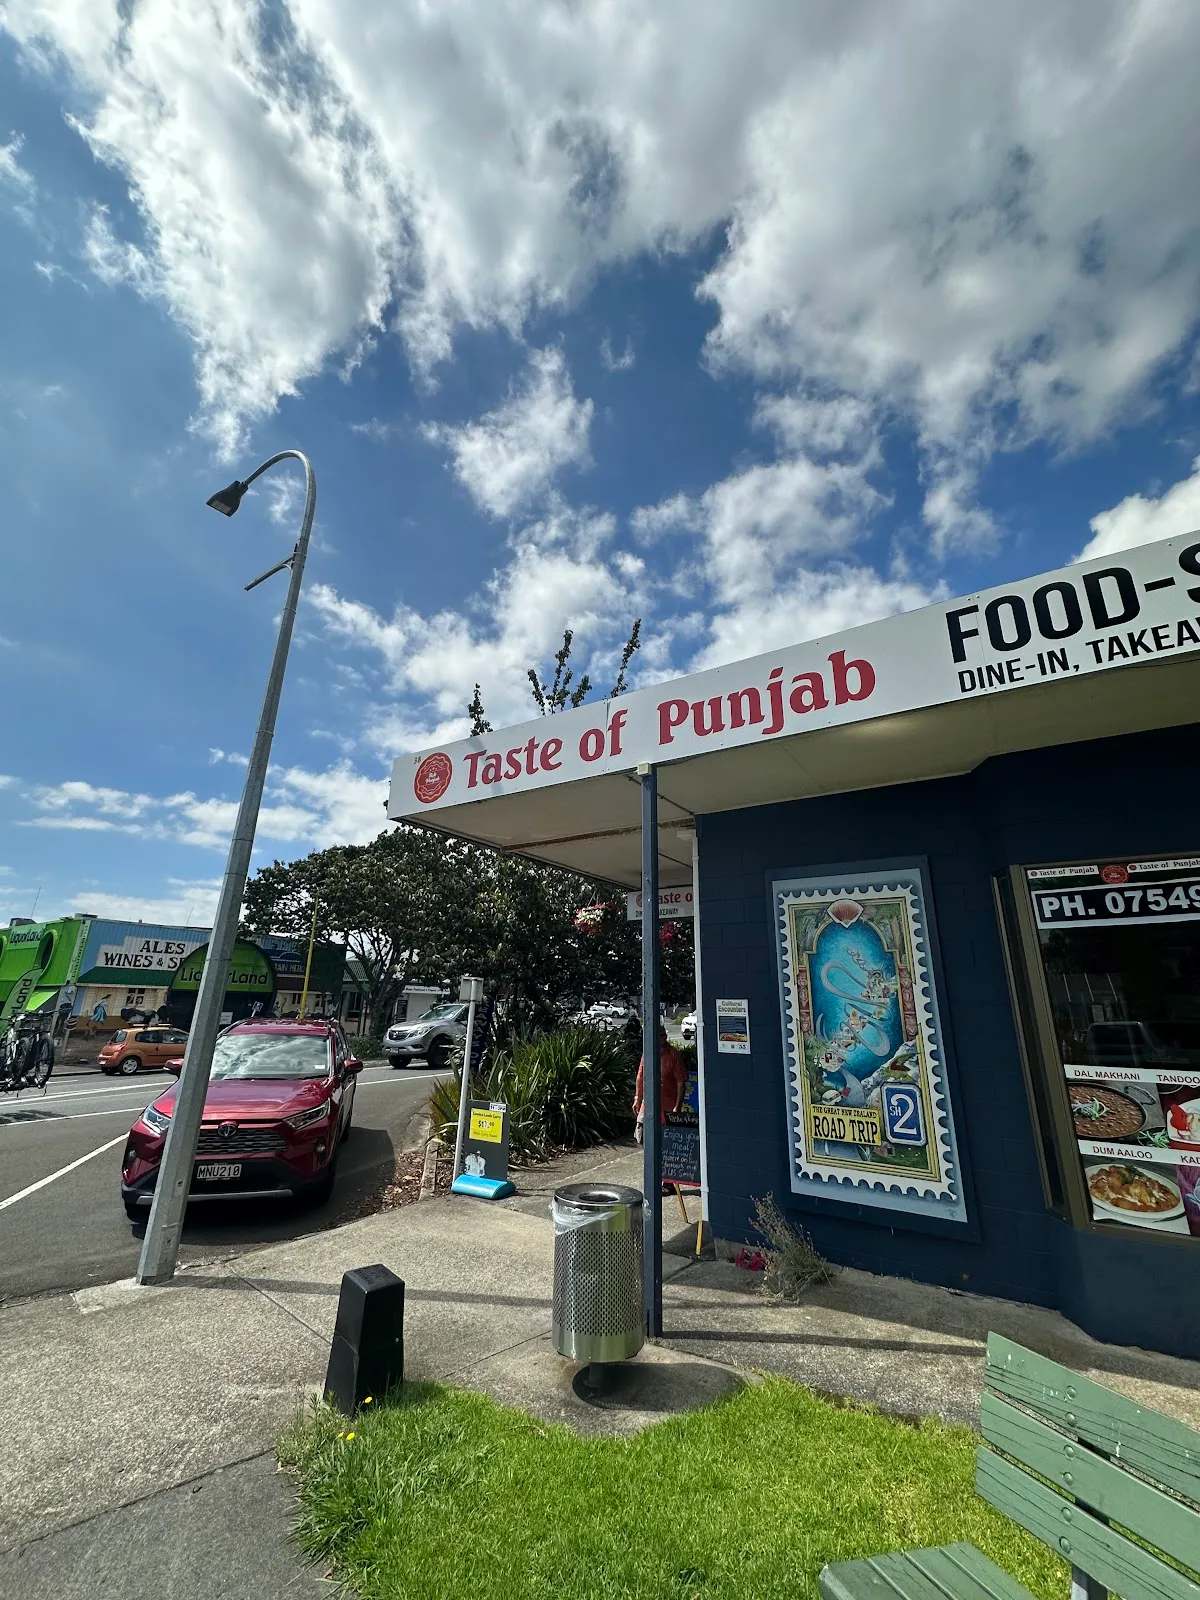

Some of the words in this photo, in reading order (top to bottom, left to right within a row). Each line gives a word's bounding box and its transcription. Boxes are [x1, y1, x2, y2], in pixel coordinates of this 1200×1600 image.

[958, 648, 1080, 693] DINE-IN,
[1085, 616, 1200, 664] TAKEA
[463, 736, 563, 789] Taste
[579, 709, 628, 762] of
[656, 649, 876, 745] Punjab
[1069, 866, 1095, 874] Punjab
[658, 892, 681, 905] aste
[1041, 894, 1096, 918] PH.
[1104, 884, 1200, 914] 07549
[139, 941, 186, 955] ALES
[104, 953, 153, 967] WINES
[156, 957, 164, 967] &
[1074, 1069, 1093, 1078] DAL
[1095, 1071, 1140, 1081] MAKHANI
[1156, 1074, 1200, 1084] TANDOO
[824, 1108, 840, 1116] GREAT
[853, 1111, 877, 1119] ZEALAND
[889, 1106, 901, 1116] SH
[891, 1094, 917, 1135] 2
[813, 1116, 846, 1140] ROAD
[849, 1119, 878, 1144] TRIP
[1093, 1145, 1115, 1155] DUM
[1117, 1148, 1153, 1159] AALOO
